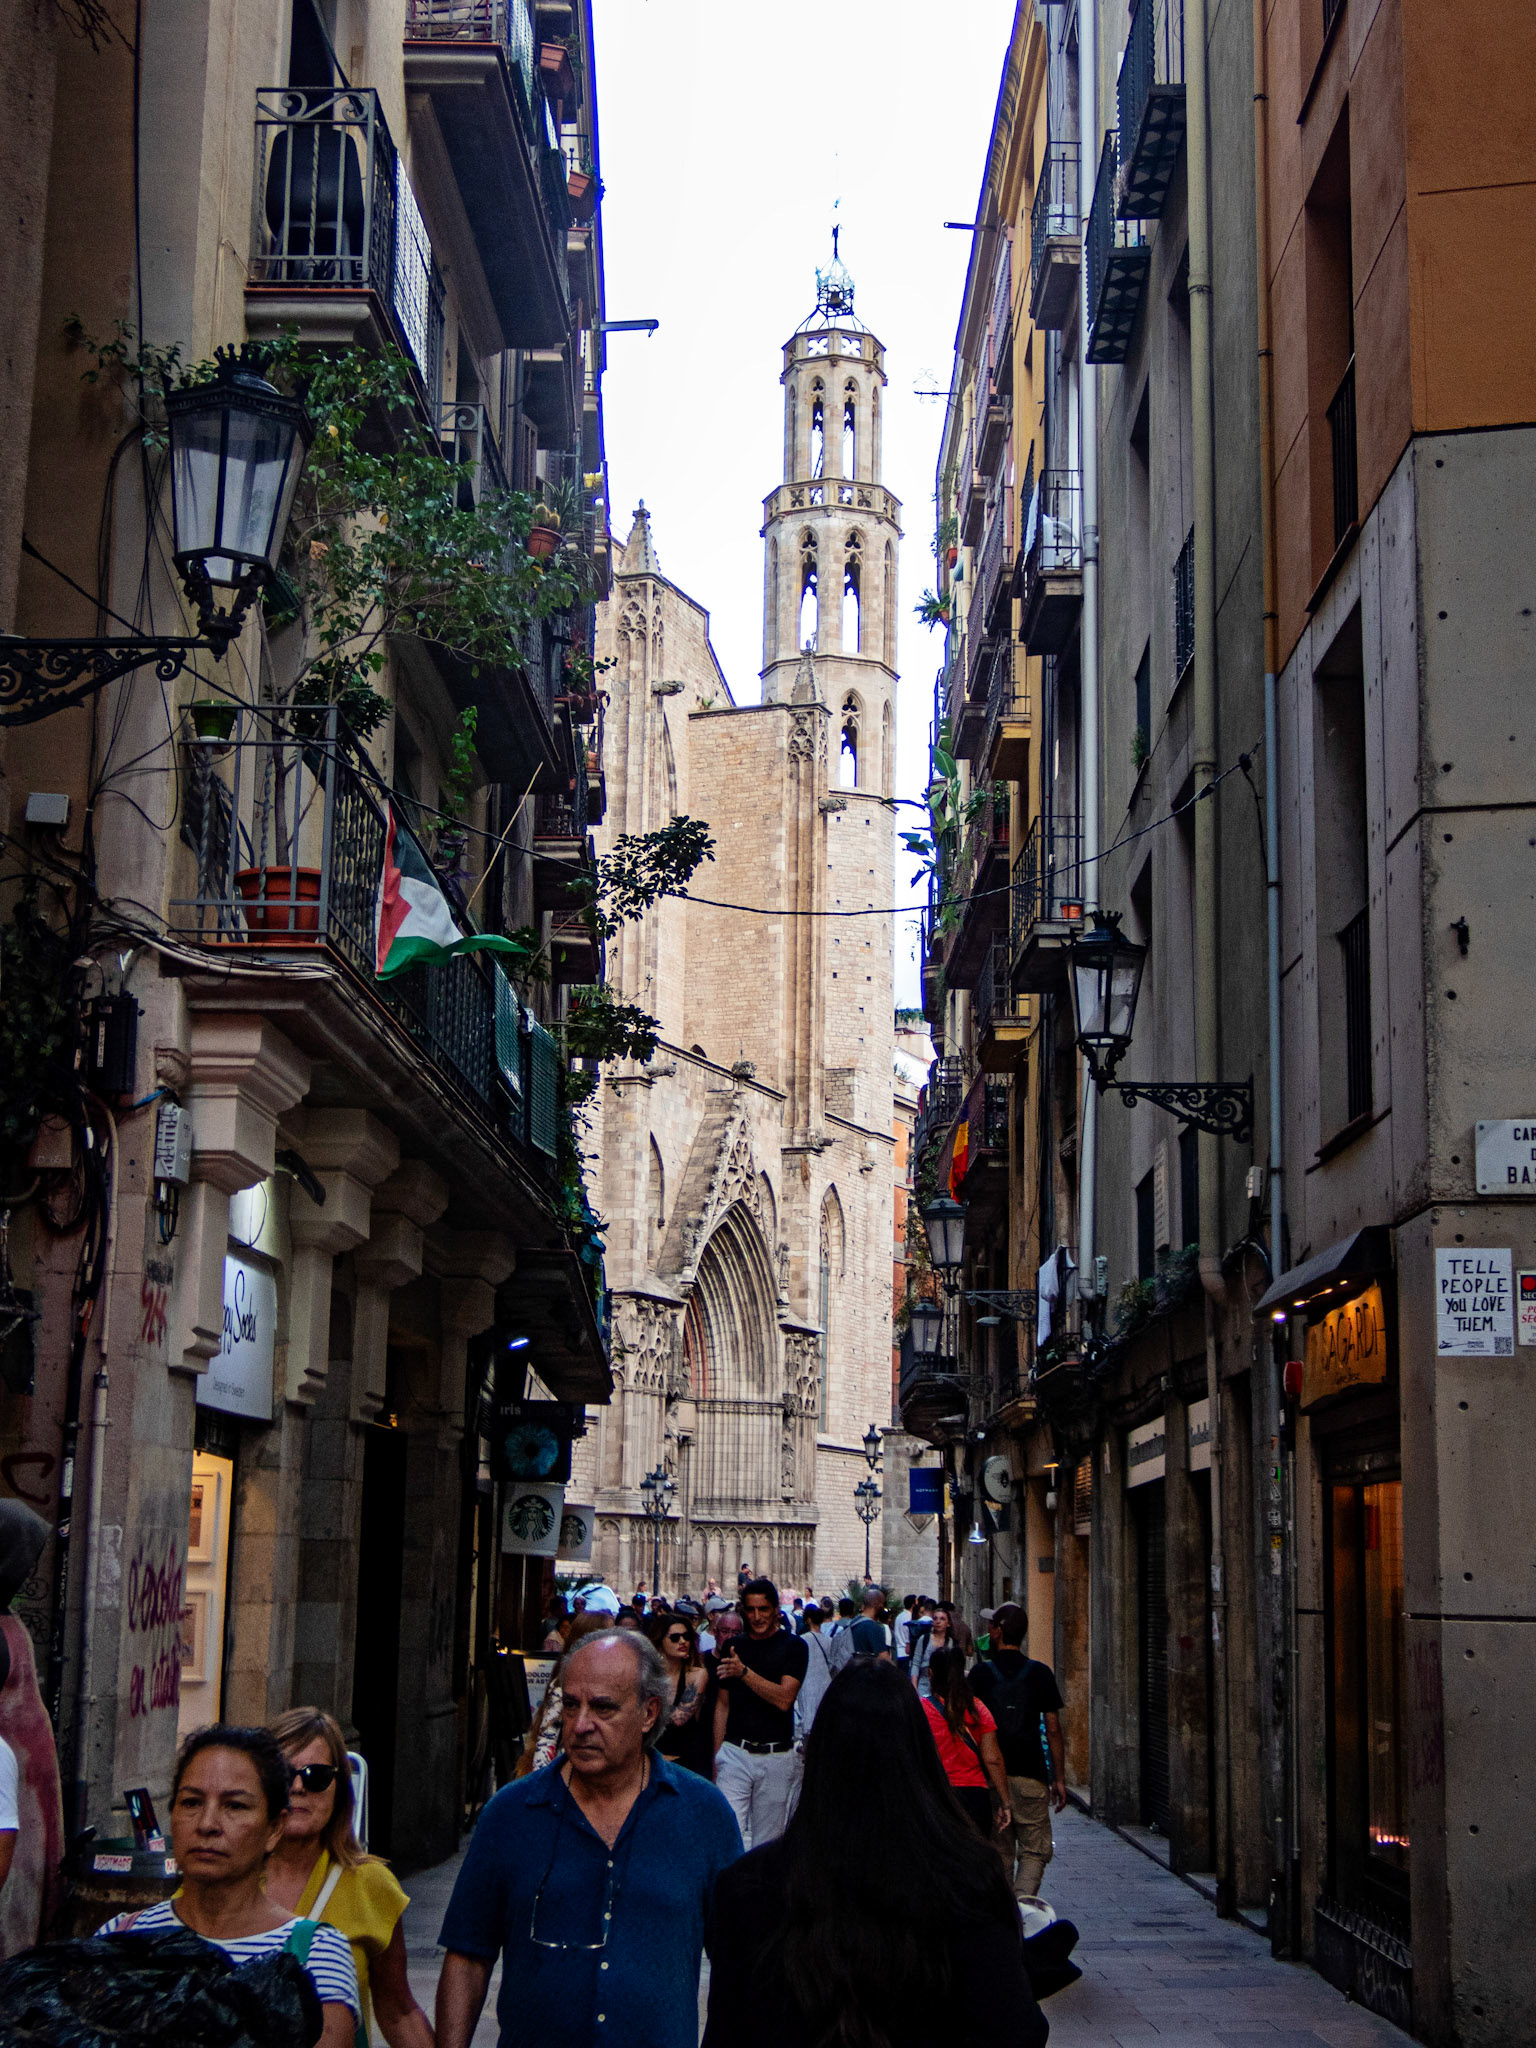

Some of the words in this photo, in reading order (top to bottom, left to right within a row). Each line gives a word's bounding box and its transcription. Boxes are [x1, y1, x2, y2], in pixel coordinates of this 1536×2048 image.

[1508, 1166, 1536, 1184] BA
[1448, 1260, 1500, 1274] TELL
[1441, 1278, 1508, 1293] PEOPLE
[233, 1269, 258, 1343] Socks
[1472, 1296, 1506, 1312] LOVE
[1453, 1316, 1497, 1332] THEM.
